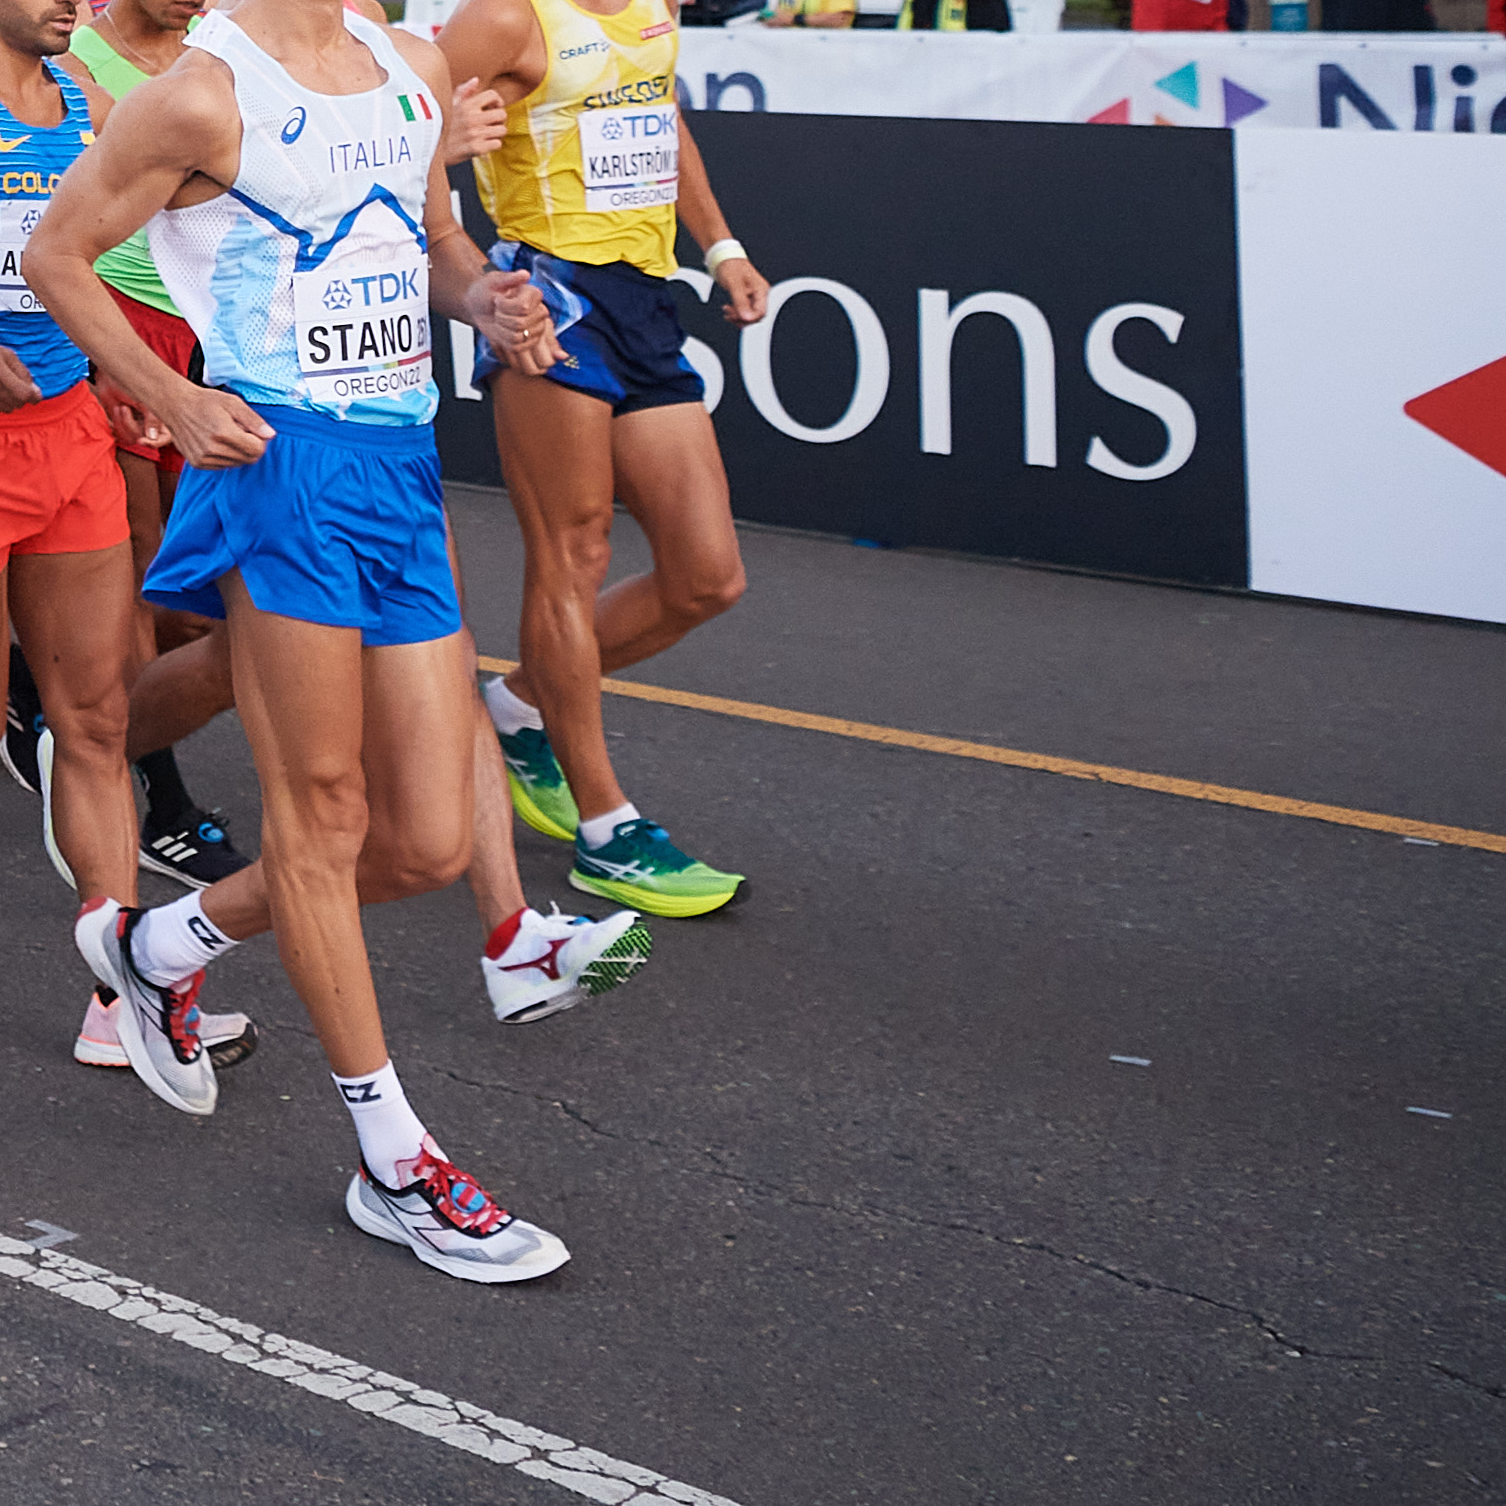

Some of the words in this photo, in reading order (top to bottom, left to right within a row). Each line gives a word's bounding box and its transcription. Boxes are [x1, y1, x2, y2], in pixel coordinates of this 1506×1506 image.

[559, 41, 599, 61] CRAFT
[623, 111, 676, 138] TDK
[329, 135, 412, 174] ITALIA
[351, 267, 420, 307] TDK
[307, 313, 413, 366] STANO
[333, 365, 421, 398] OREGON22
